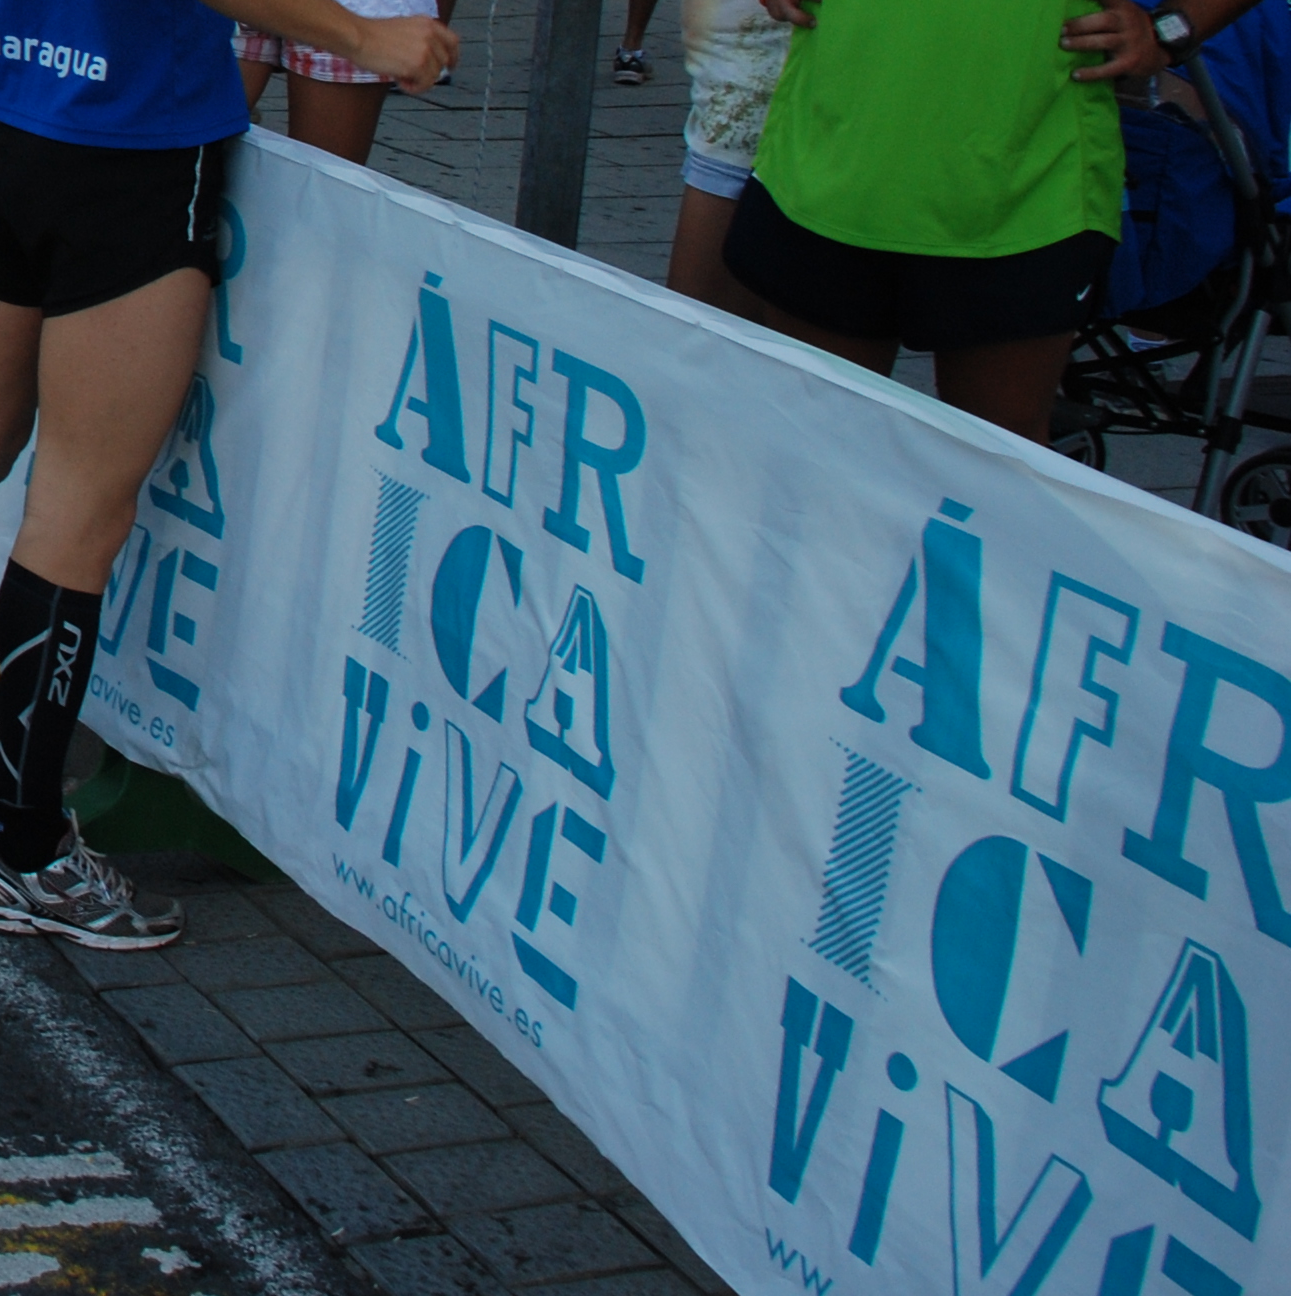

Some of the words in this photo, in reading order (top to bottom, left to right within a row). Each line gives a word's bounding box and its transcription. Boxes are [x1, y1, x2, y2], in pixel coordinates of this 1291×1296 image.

[375, 270, 644, 584] ÁFR
[47, 620, 82, 708] 2XU
[100, 522, 218, 712] VE
[352, 465, 617, 801] ICA
[838, 496, 1291, 948] ÁFR
[801, 737, 1261, 1242] ICA
